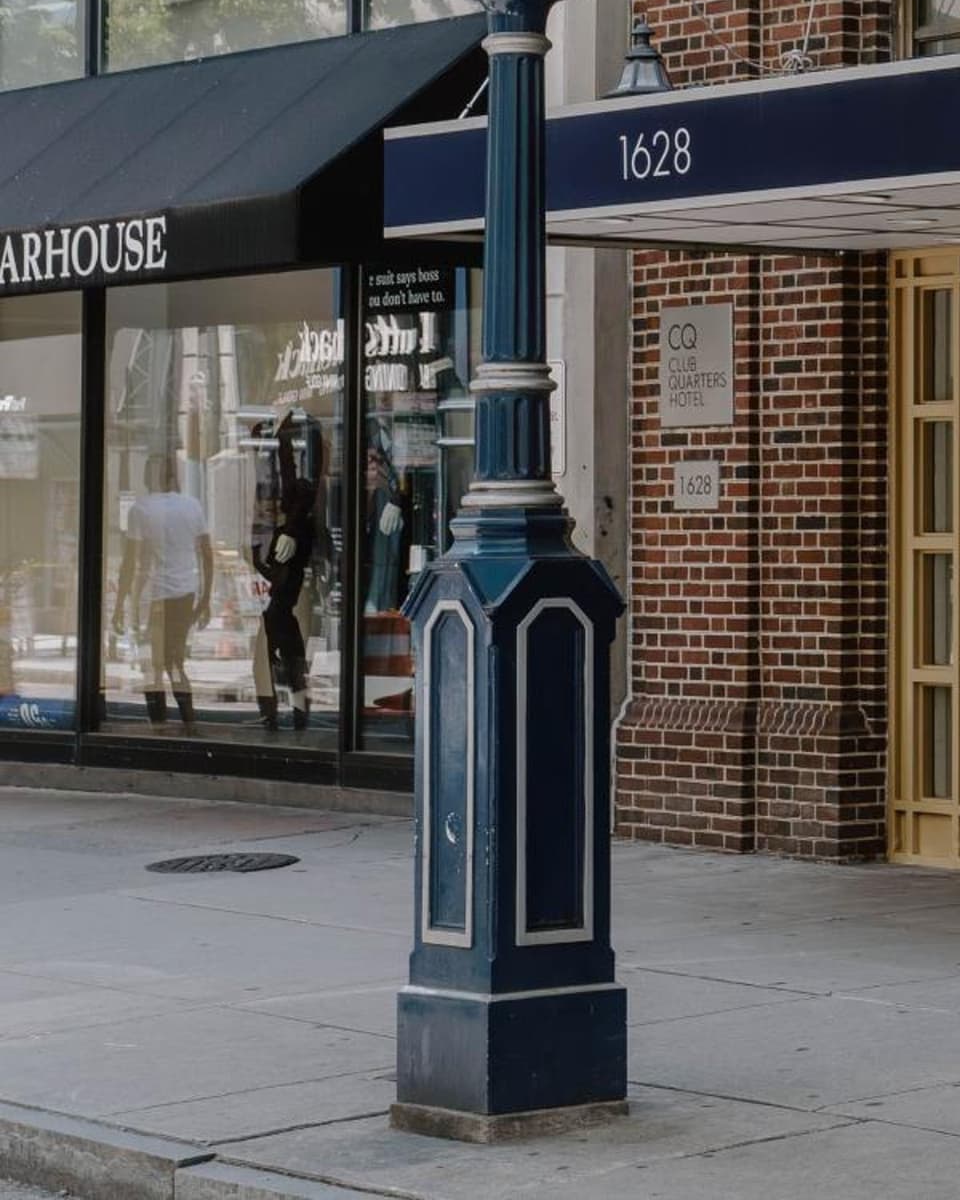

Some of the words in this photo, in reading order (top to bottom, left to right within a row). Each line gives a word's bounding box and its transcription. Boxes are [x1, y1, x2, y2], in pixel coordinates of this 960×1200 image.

[619, 128, 692, 180] 1628
[0, 215, 167, 285] ARHOUSE
[397, 272, 417, 288] says
[418, 267, 440, 283] boss
[668, 323, 697, 350] CQ
[668, 356, 697, 373] CLUB
[668, 371, 727, 390] QUARTERS
[669, 390, 704, 408] HOTEL
[680, 474, 712, 496] 1628
